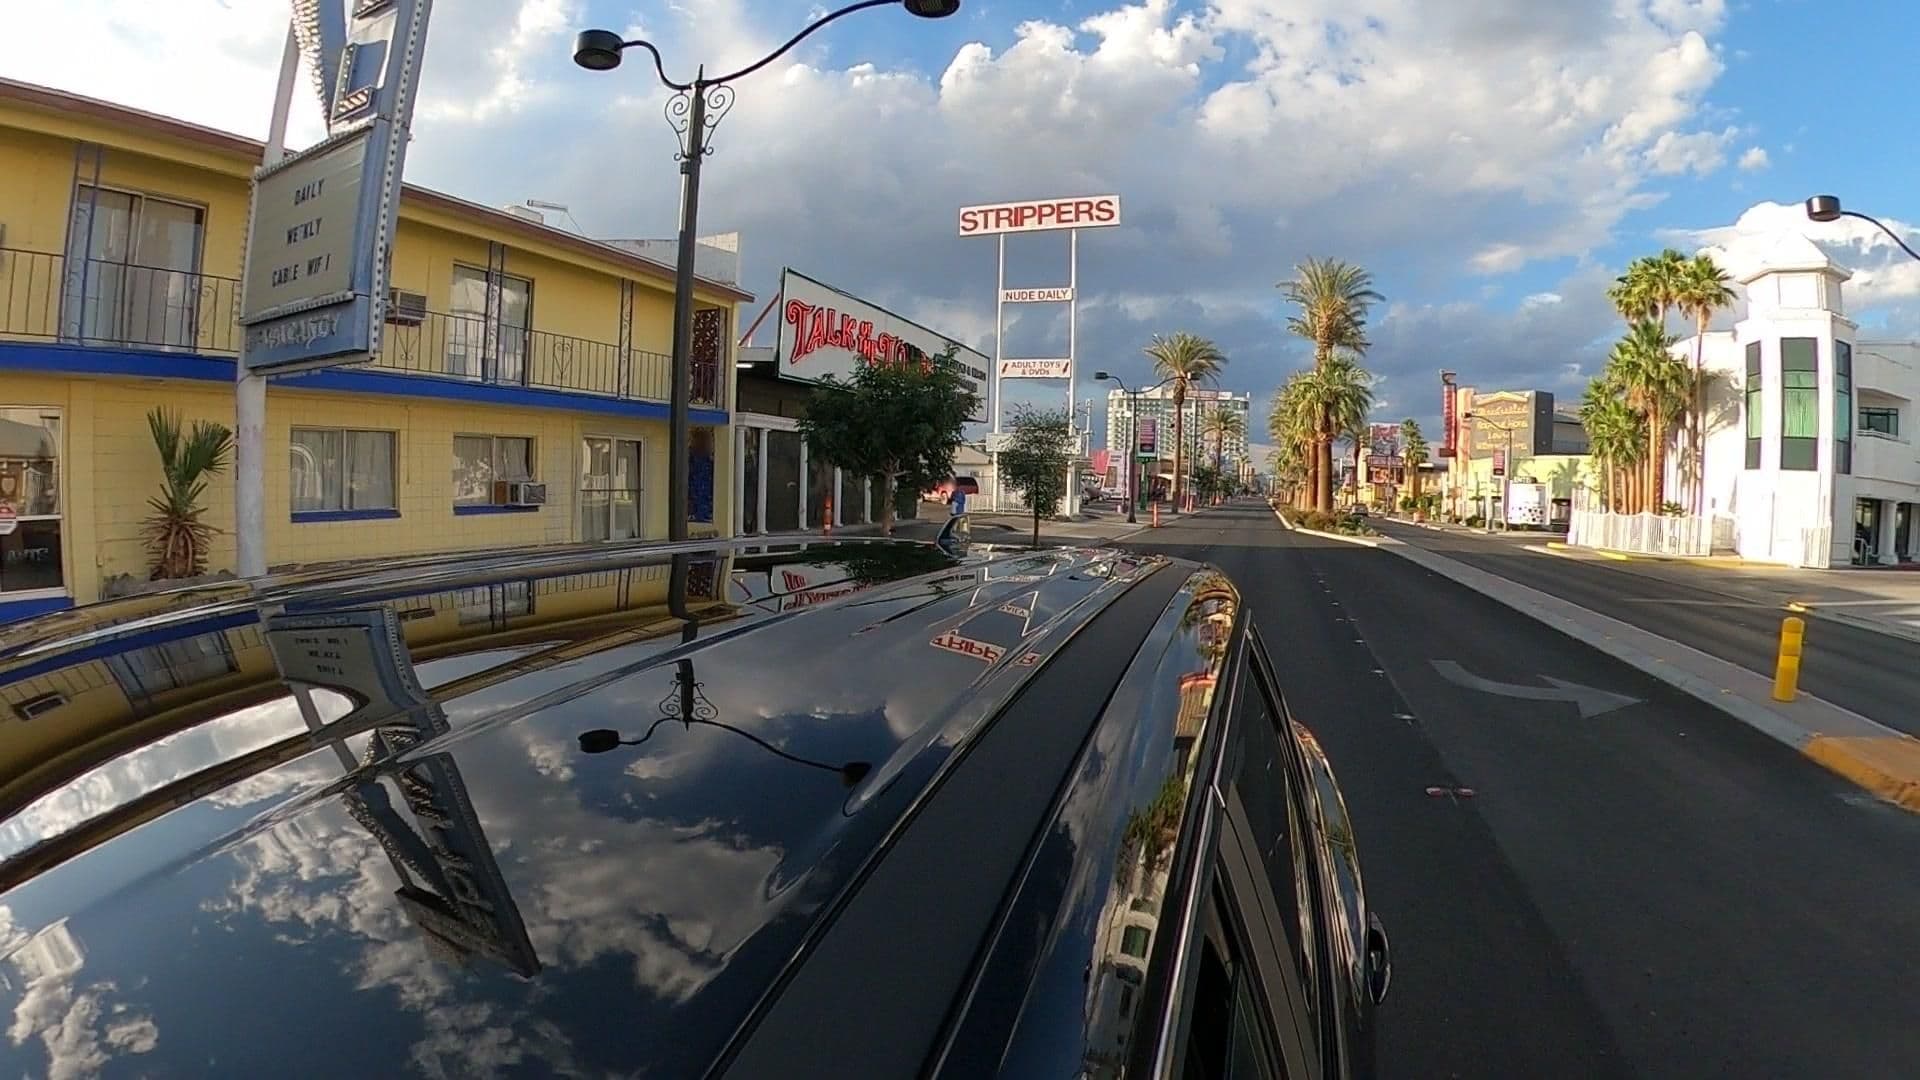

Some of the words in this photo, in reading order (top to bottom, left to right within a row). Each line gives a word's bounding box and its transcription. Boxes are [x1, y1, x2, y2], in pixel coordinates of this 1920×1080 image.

[294, 178, 325, 206] DAILY
[961, 199, 1115, 232] STRIPPERS
[287, 217, 322, 244] WEKLY
[1005, 289, 1035, 301] NUDE
[1038, 288, 1068, 300] DAILY
[786, 298, 857, 365] TALK
[878, 332, 936, 378] TO
[1011, 361, 1036, 369] ADULT
[1039, 361, 1061, 369] TOYS
